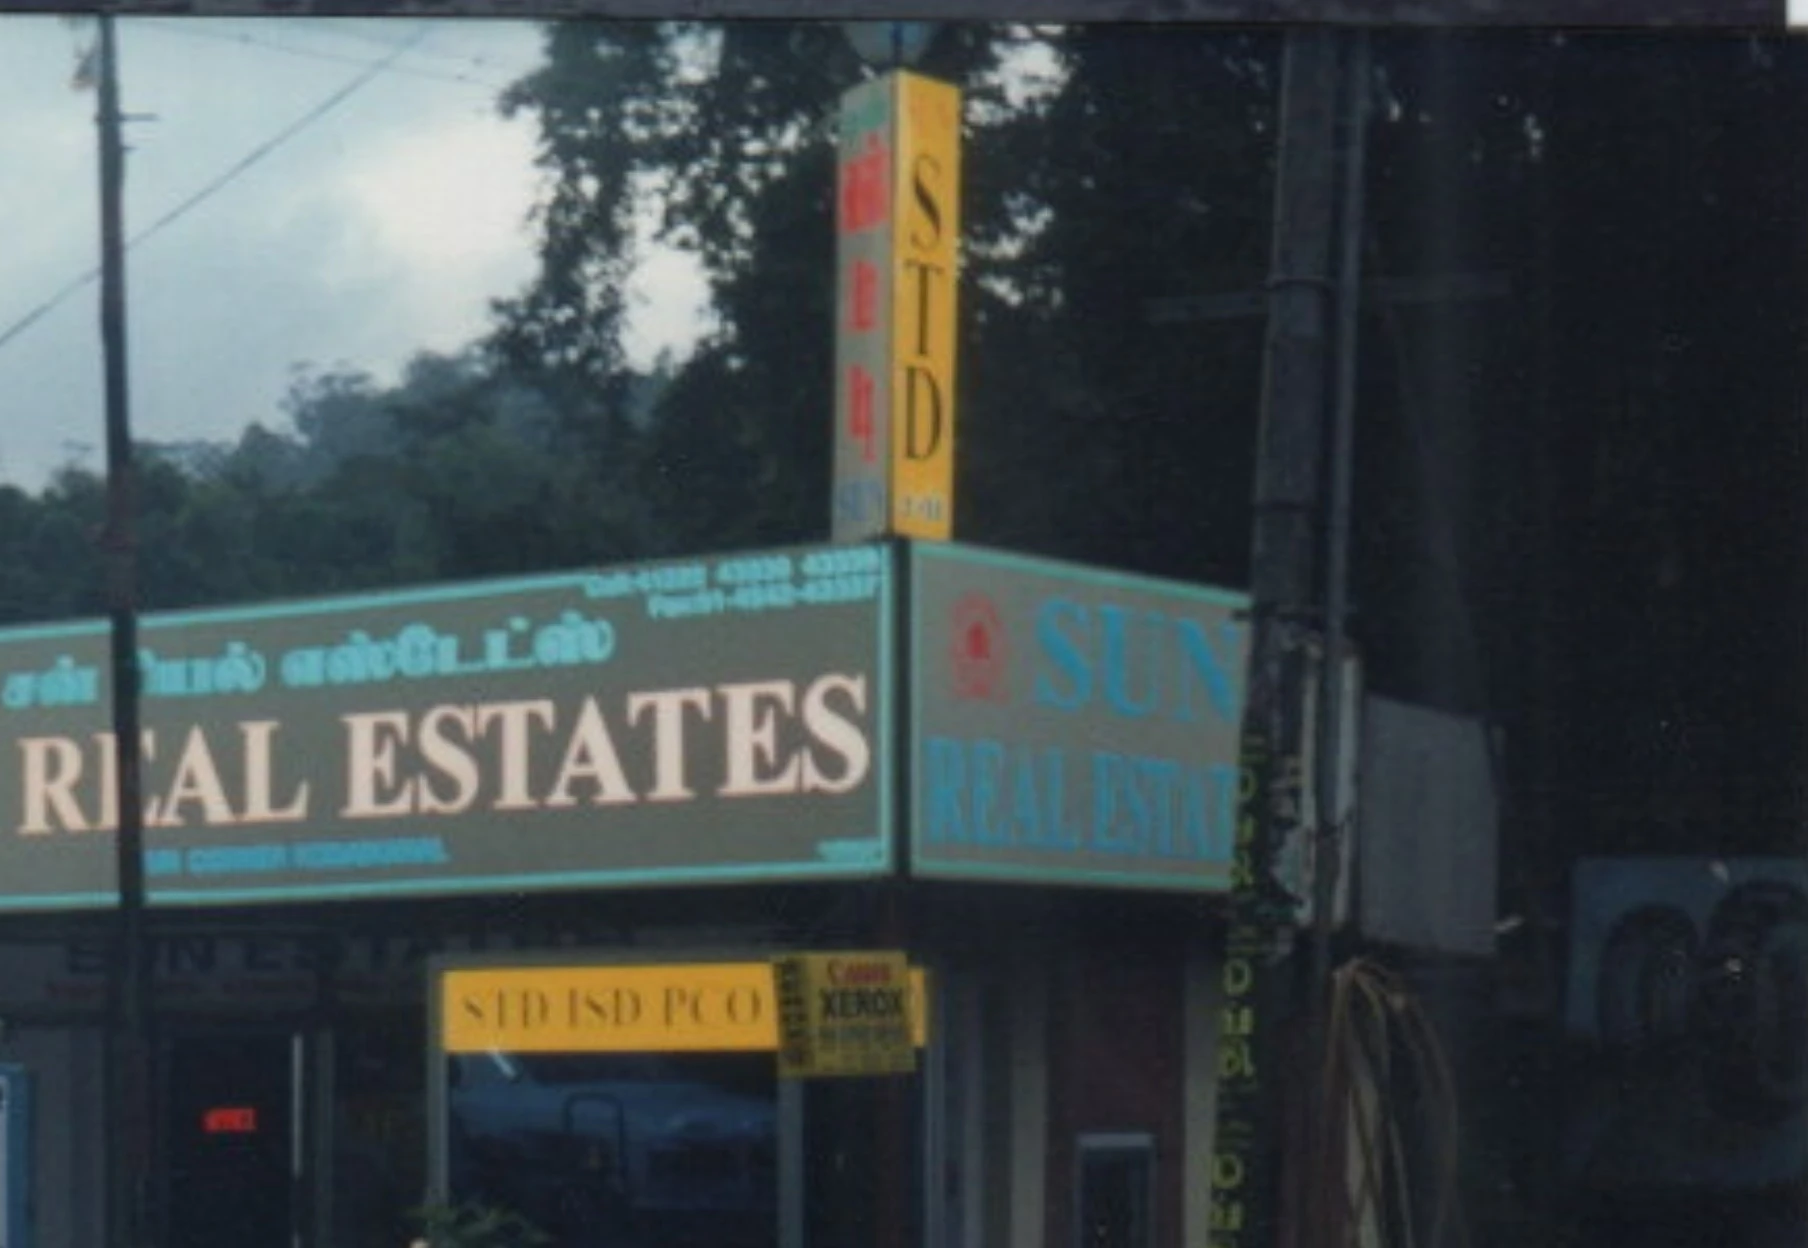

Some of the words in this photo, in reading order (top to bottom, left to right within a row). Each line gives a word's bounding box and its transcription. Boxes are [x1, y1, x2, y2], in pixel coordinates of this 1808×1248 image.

[901, 152, 943, 461] STD
[1034, 595, 1242, 724] SUN
[17, 720, 310, 837] REAL
[339, 673, 871, 821] ESTATES
[923, 735, 1079, 851] REAL
[463, 988, 549, 1030] STD
[568, 987, 642, 1029] ISD
[663, 985, 761, 1028] PCO
[819, 987, 903, 1021] XEROX
